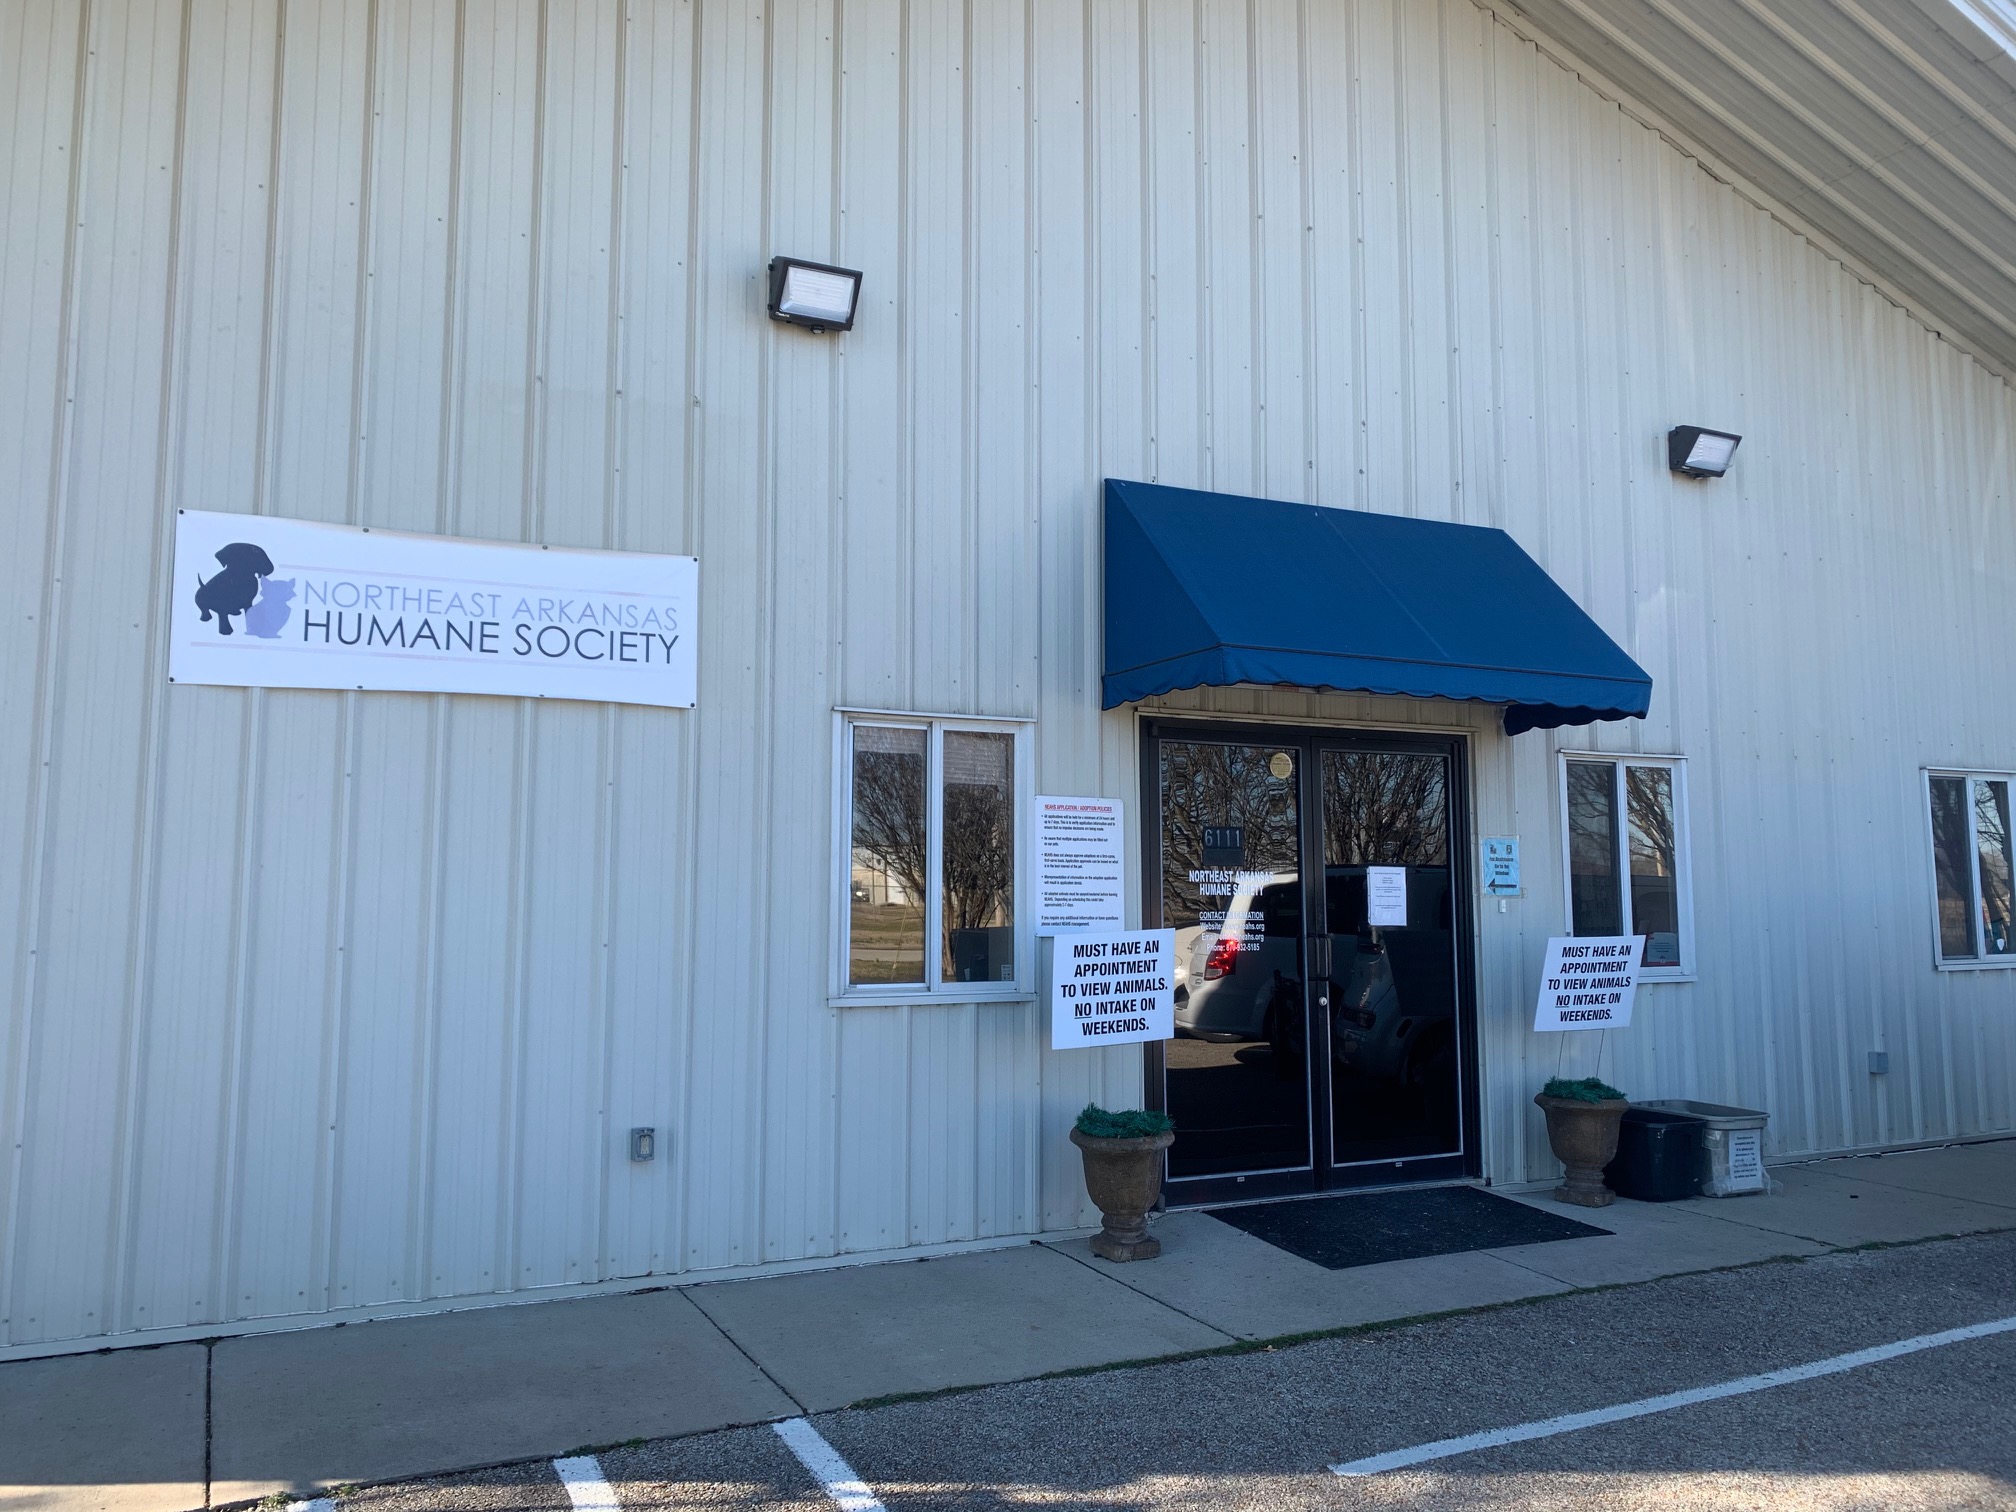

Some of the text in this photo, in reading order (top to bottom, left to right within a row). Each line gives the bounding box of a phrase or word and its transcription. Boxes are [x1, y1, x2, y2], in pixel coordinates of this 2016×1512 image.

[304, 579, 678, 631] NORTHEAST ARKANSAS
[303, 609, 679, 665] HUMANE SOCIETY
[1204, 828, 1241, 847] 6111
[1189, 870, 1274, 883] NORTHEAST ARKANSAS
[1199, 883, 1263, 896] HUMANE SOCIETY
[1199, 911, 1225, 919] CONTACT
[1073, 940, 1159, 958] MUST HAVE AN
[1562, 945, 1632, 958] MUST HAVE AN
[1074, 959, 1158, 978] APPOINTMENT
[1560, 961, 1628, 974] APPOINTMENT
[1061, 977, 1168, 998] TO VIEW ANIMALS.
[1548, 976, 1631, 990] TO VIEW ANIMALS
[1075, 997, 1156, 1017] NO INTAKE ON
[1556, 993, 1621, 1006] NO INTAKE ON
[1560, 1009, 1612, 1022] WEEKENDS.
[1082, 1017, 1149, 1036] WEEKENDS.
